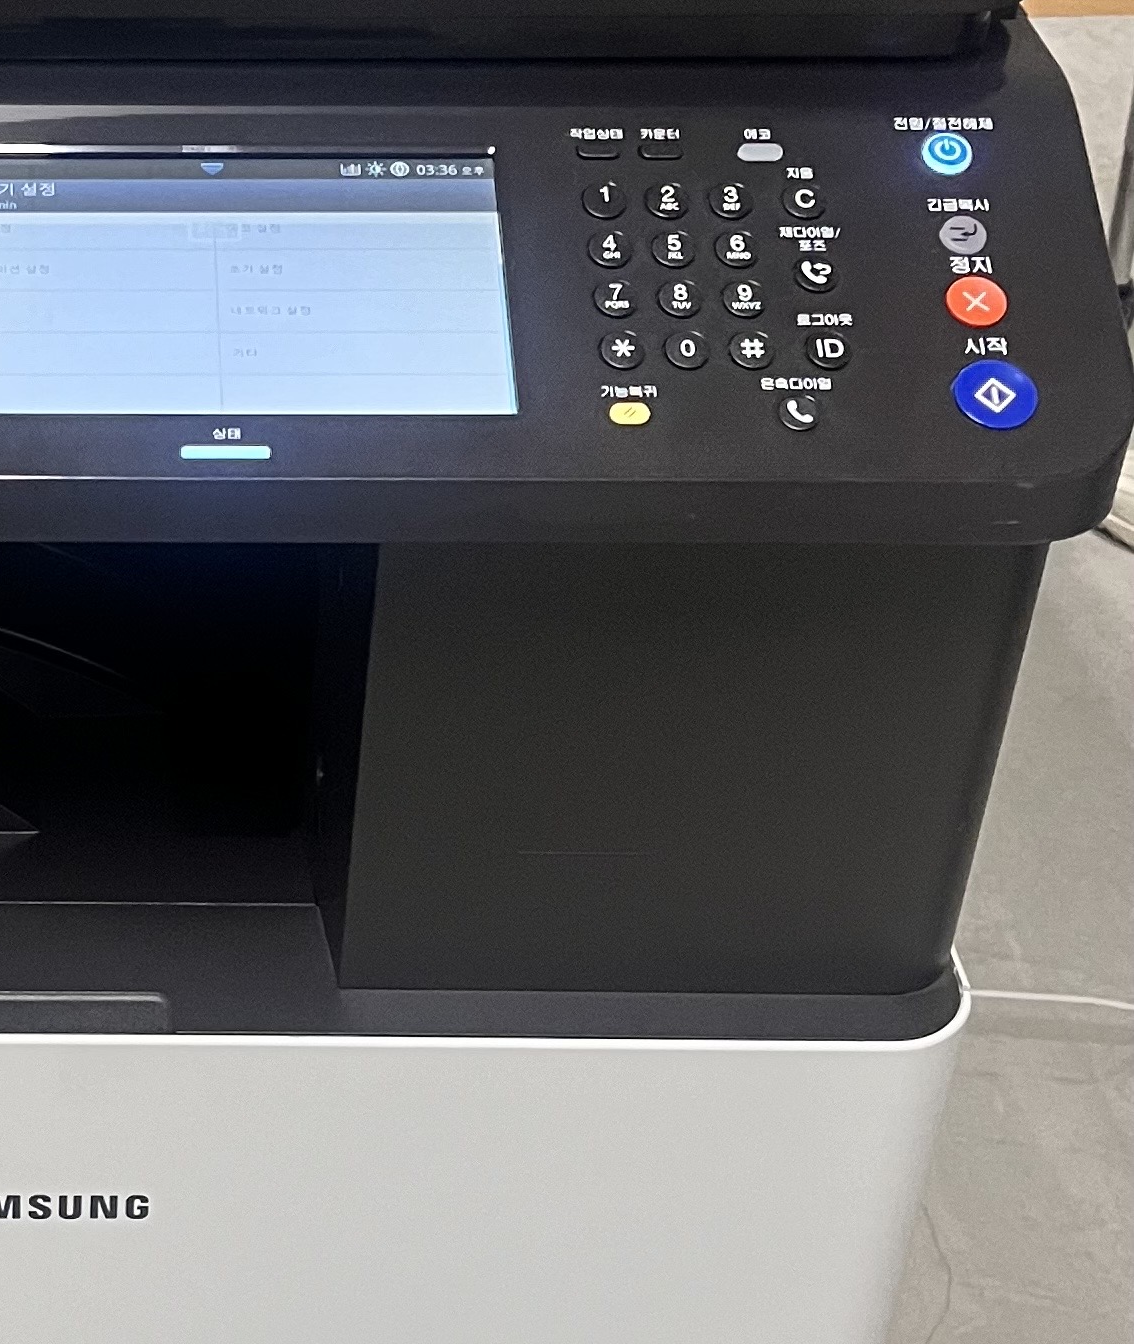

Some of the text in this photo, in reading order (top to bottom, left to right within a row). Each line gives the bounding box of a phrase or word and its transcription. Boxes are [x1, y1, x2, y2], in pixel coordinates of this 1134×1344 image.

[640, 128, 680, 140] 카운터
[416, 164, 458, 176] 03:36
[20, 182, 57, 198] 설정
[599, 186, 610, 203] 1
[660, 185, 675, 203] 2
[723, 186, 739, 203] 3
[794, 188, 816, 209] C
[659, 202, 680, 211] ABC
[602, 234, 617, 252] 4
[667, 234, 682, 251] 5
[729, 234, 746, 252] 6
[949, 256, 993, 275] 정지
[608, 283, 623, 301] 7
[673, 283, 688, 301] 8
[736, 284, 753, 301] 9
[671, 301, 692, 310] TUV
[731, 301, 762, 310] WXYZ
[680, 339, 696, 358] 0
[815, 338, 845, 358] ID
[964, 337, 1008, 356] 시작
[212, 427, 242, 441] 상태
